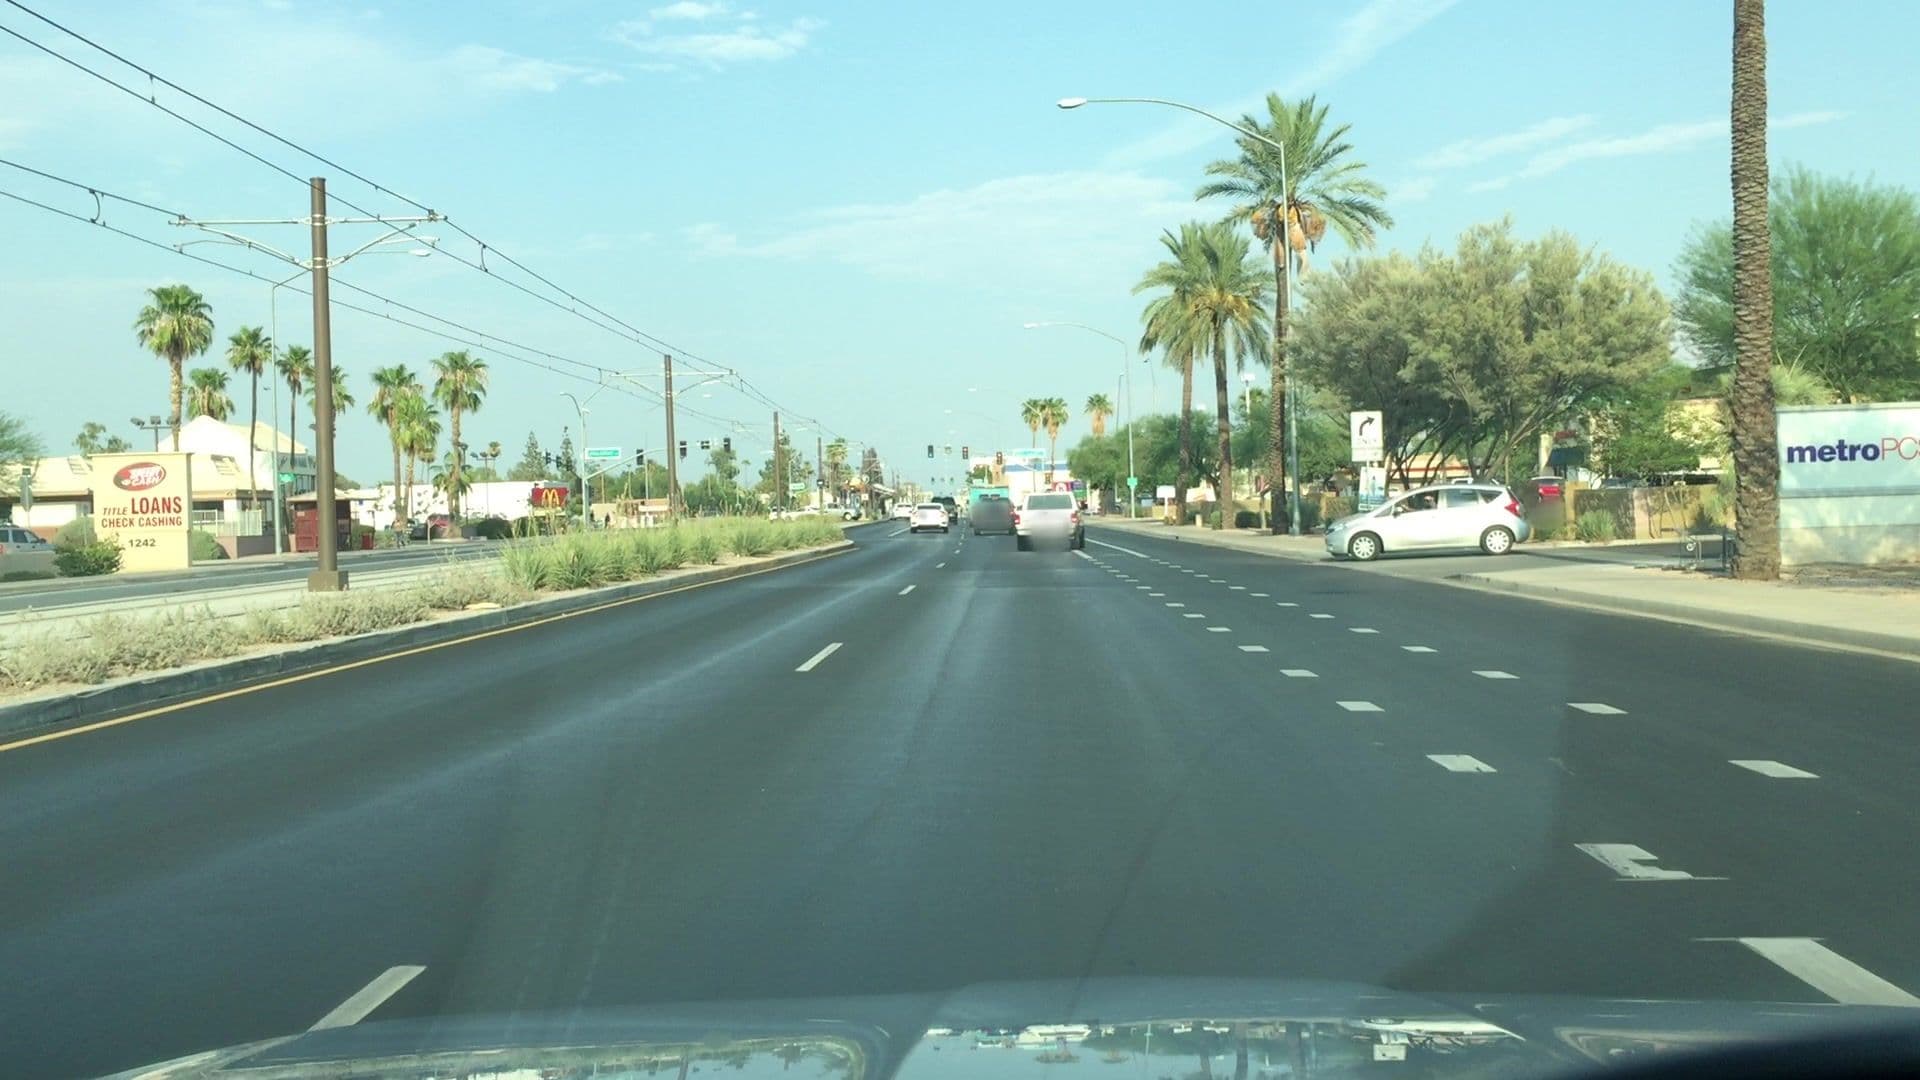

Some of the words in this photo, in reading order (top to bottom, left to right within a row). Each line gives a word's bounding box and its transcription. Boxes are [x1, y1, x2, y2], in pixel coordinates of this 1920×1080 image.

[1786, 437, 1920, 463] metroPC
[103, 507, 128, 516] TITLE
[131, 496, 182, 514] LOANS
[101, 517, 135, 528] CHECK
[138, 516, 182, 527] CASHING
[128, 538, 156, 548] 1242
